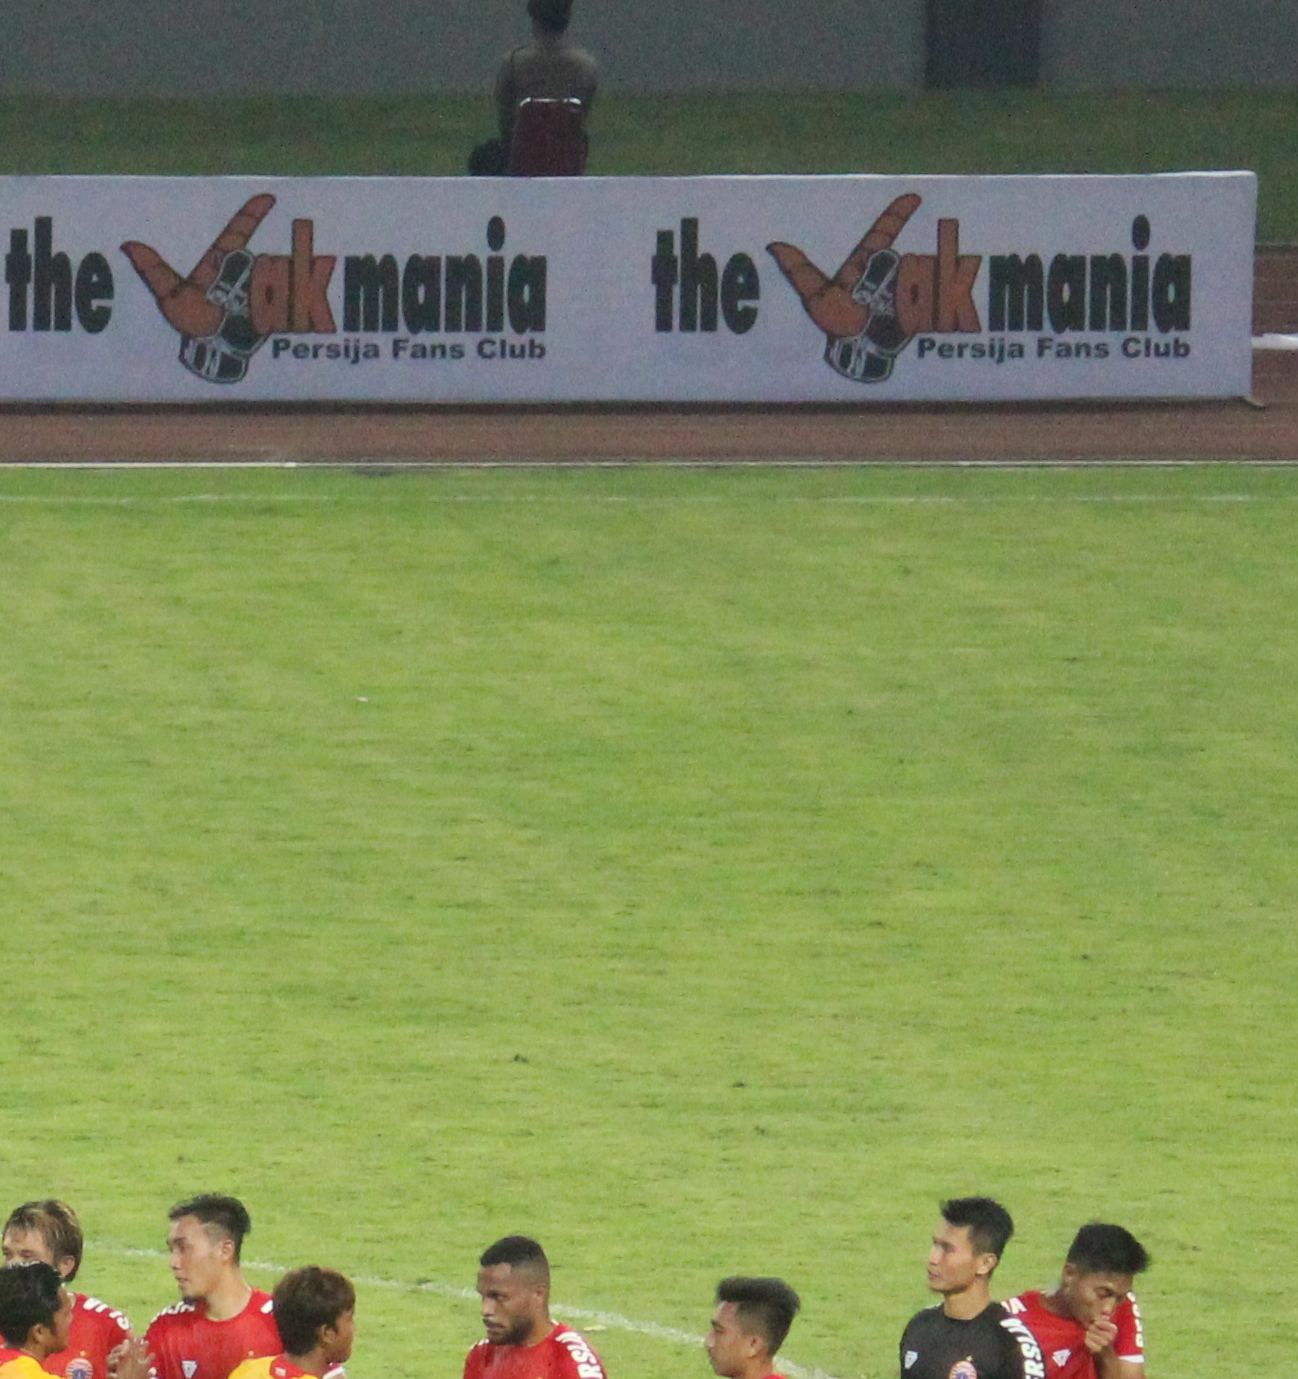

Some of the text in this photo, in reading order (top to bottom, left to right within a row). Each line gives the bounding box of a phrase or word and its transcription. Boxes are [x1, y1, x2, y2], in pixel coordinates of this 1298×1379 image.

[5, 216, 115, 334] the
[651, 217, 760, 334] the
[271, 338, 546, 364] Persija Fans Club
[916, 337, 1191, 365] Persija Fans Club
